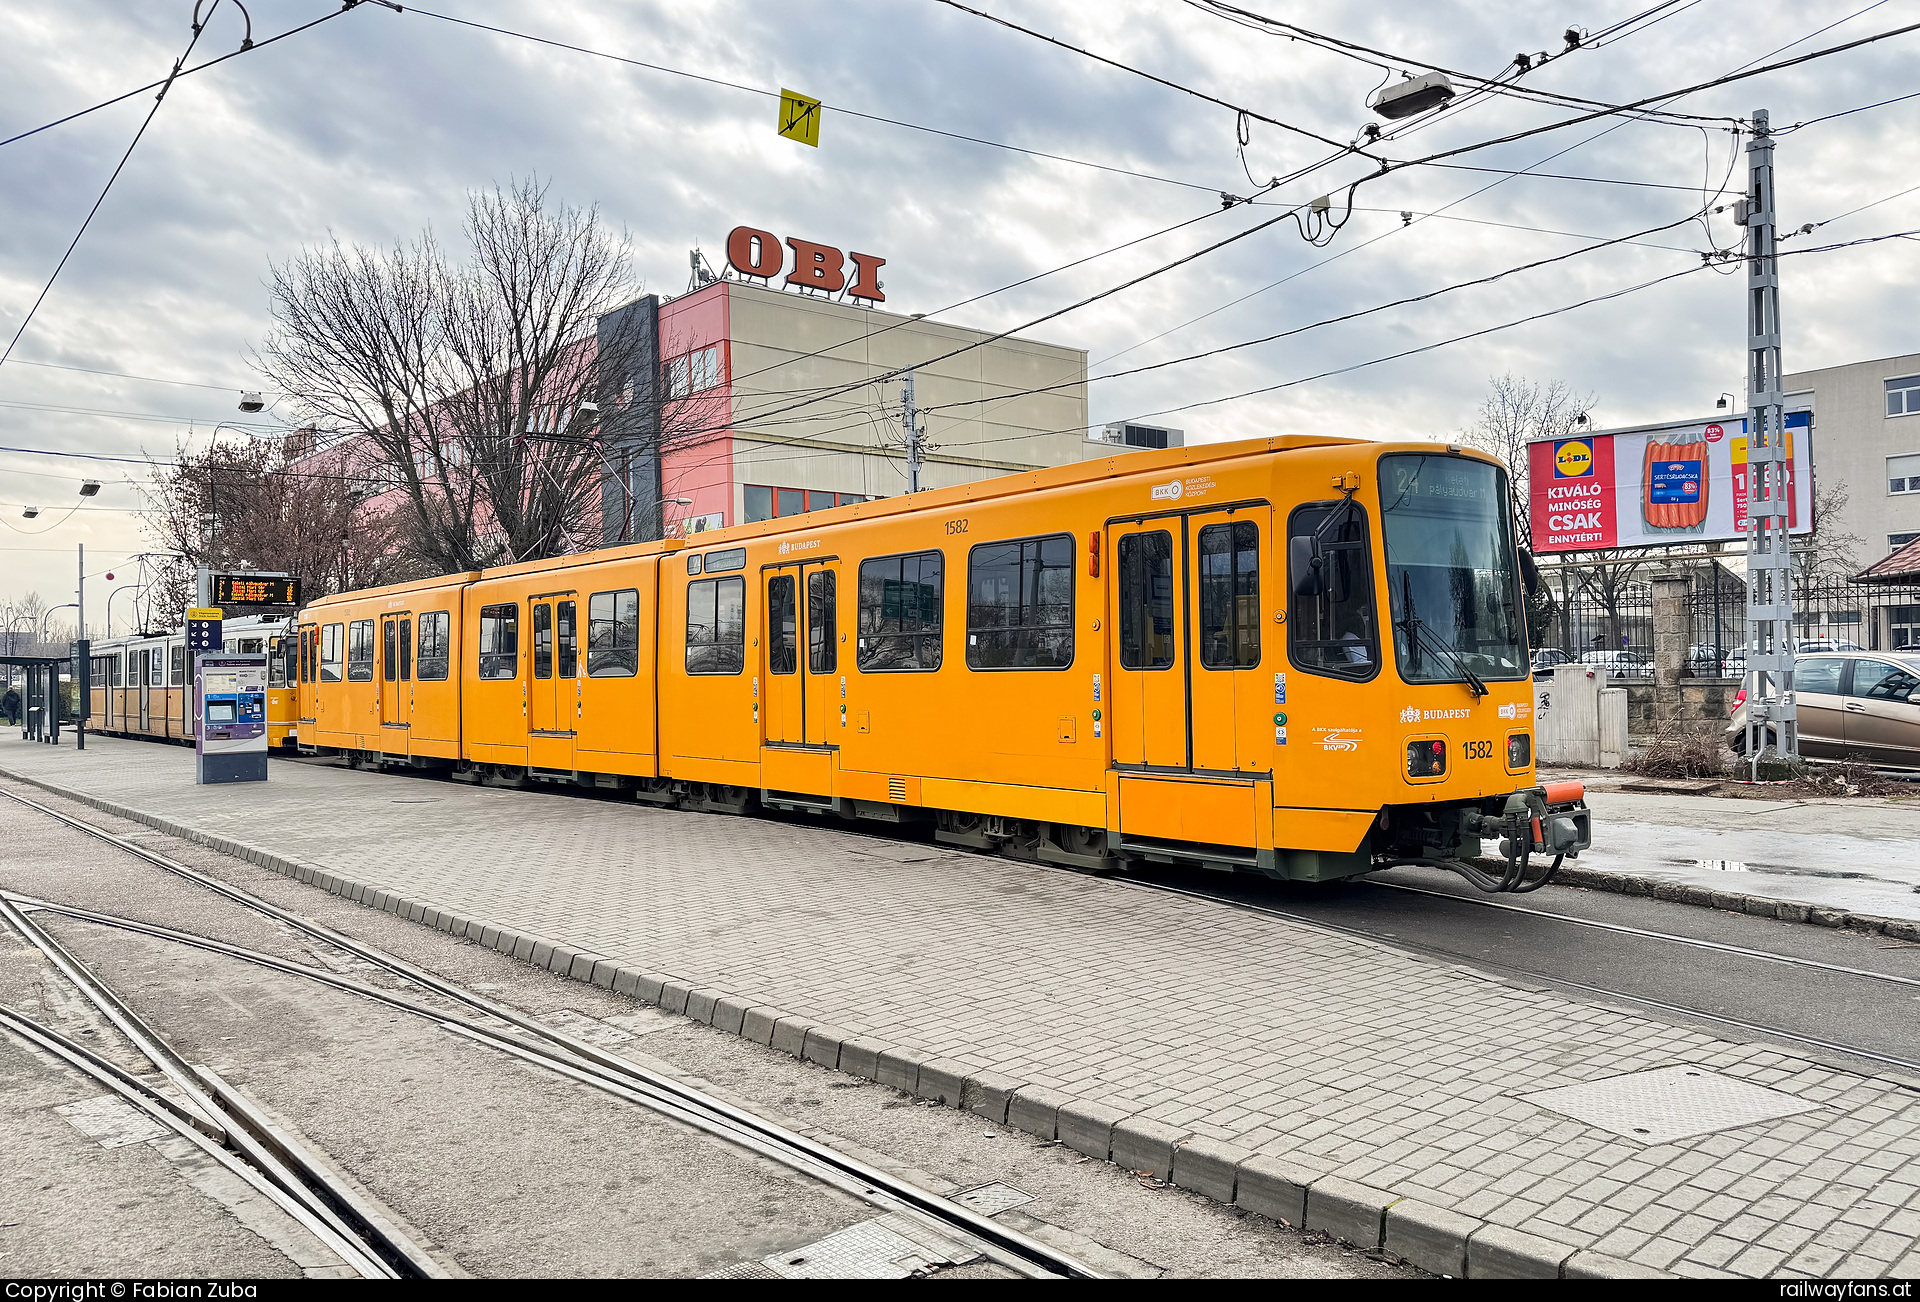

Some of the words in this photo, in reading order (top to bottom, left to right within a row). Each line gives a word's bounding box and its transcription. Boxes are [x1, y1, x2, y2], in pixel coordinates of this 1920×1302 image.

[725, 226, 886, 302] OBI
[1186, 476, 1210, 484] BUDAPESTI
[1155, 488, 1169, 496] BKK
[1430, 484, 1478, 498] pályaudvar
[1548, 482, 1601, 499] KIVÁLÓ
[1548, 498, 1601, 512] MINŐSÉG
[945, 519, 968, 535] 1582
[1549, 512, 1602, 530] CSAK
[791, 540, 820, 550] BUDAPEST
[1549, 532, 1602, 544] ENNYIÉRT!
[1424, 709, 1470, 719] BUDAPEST
[1462, 740, 1492, 759] 1582
